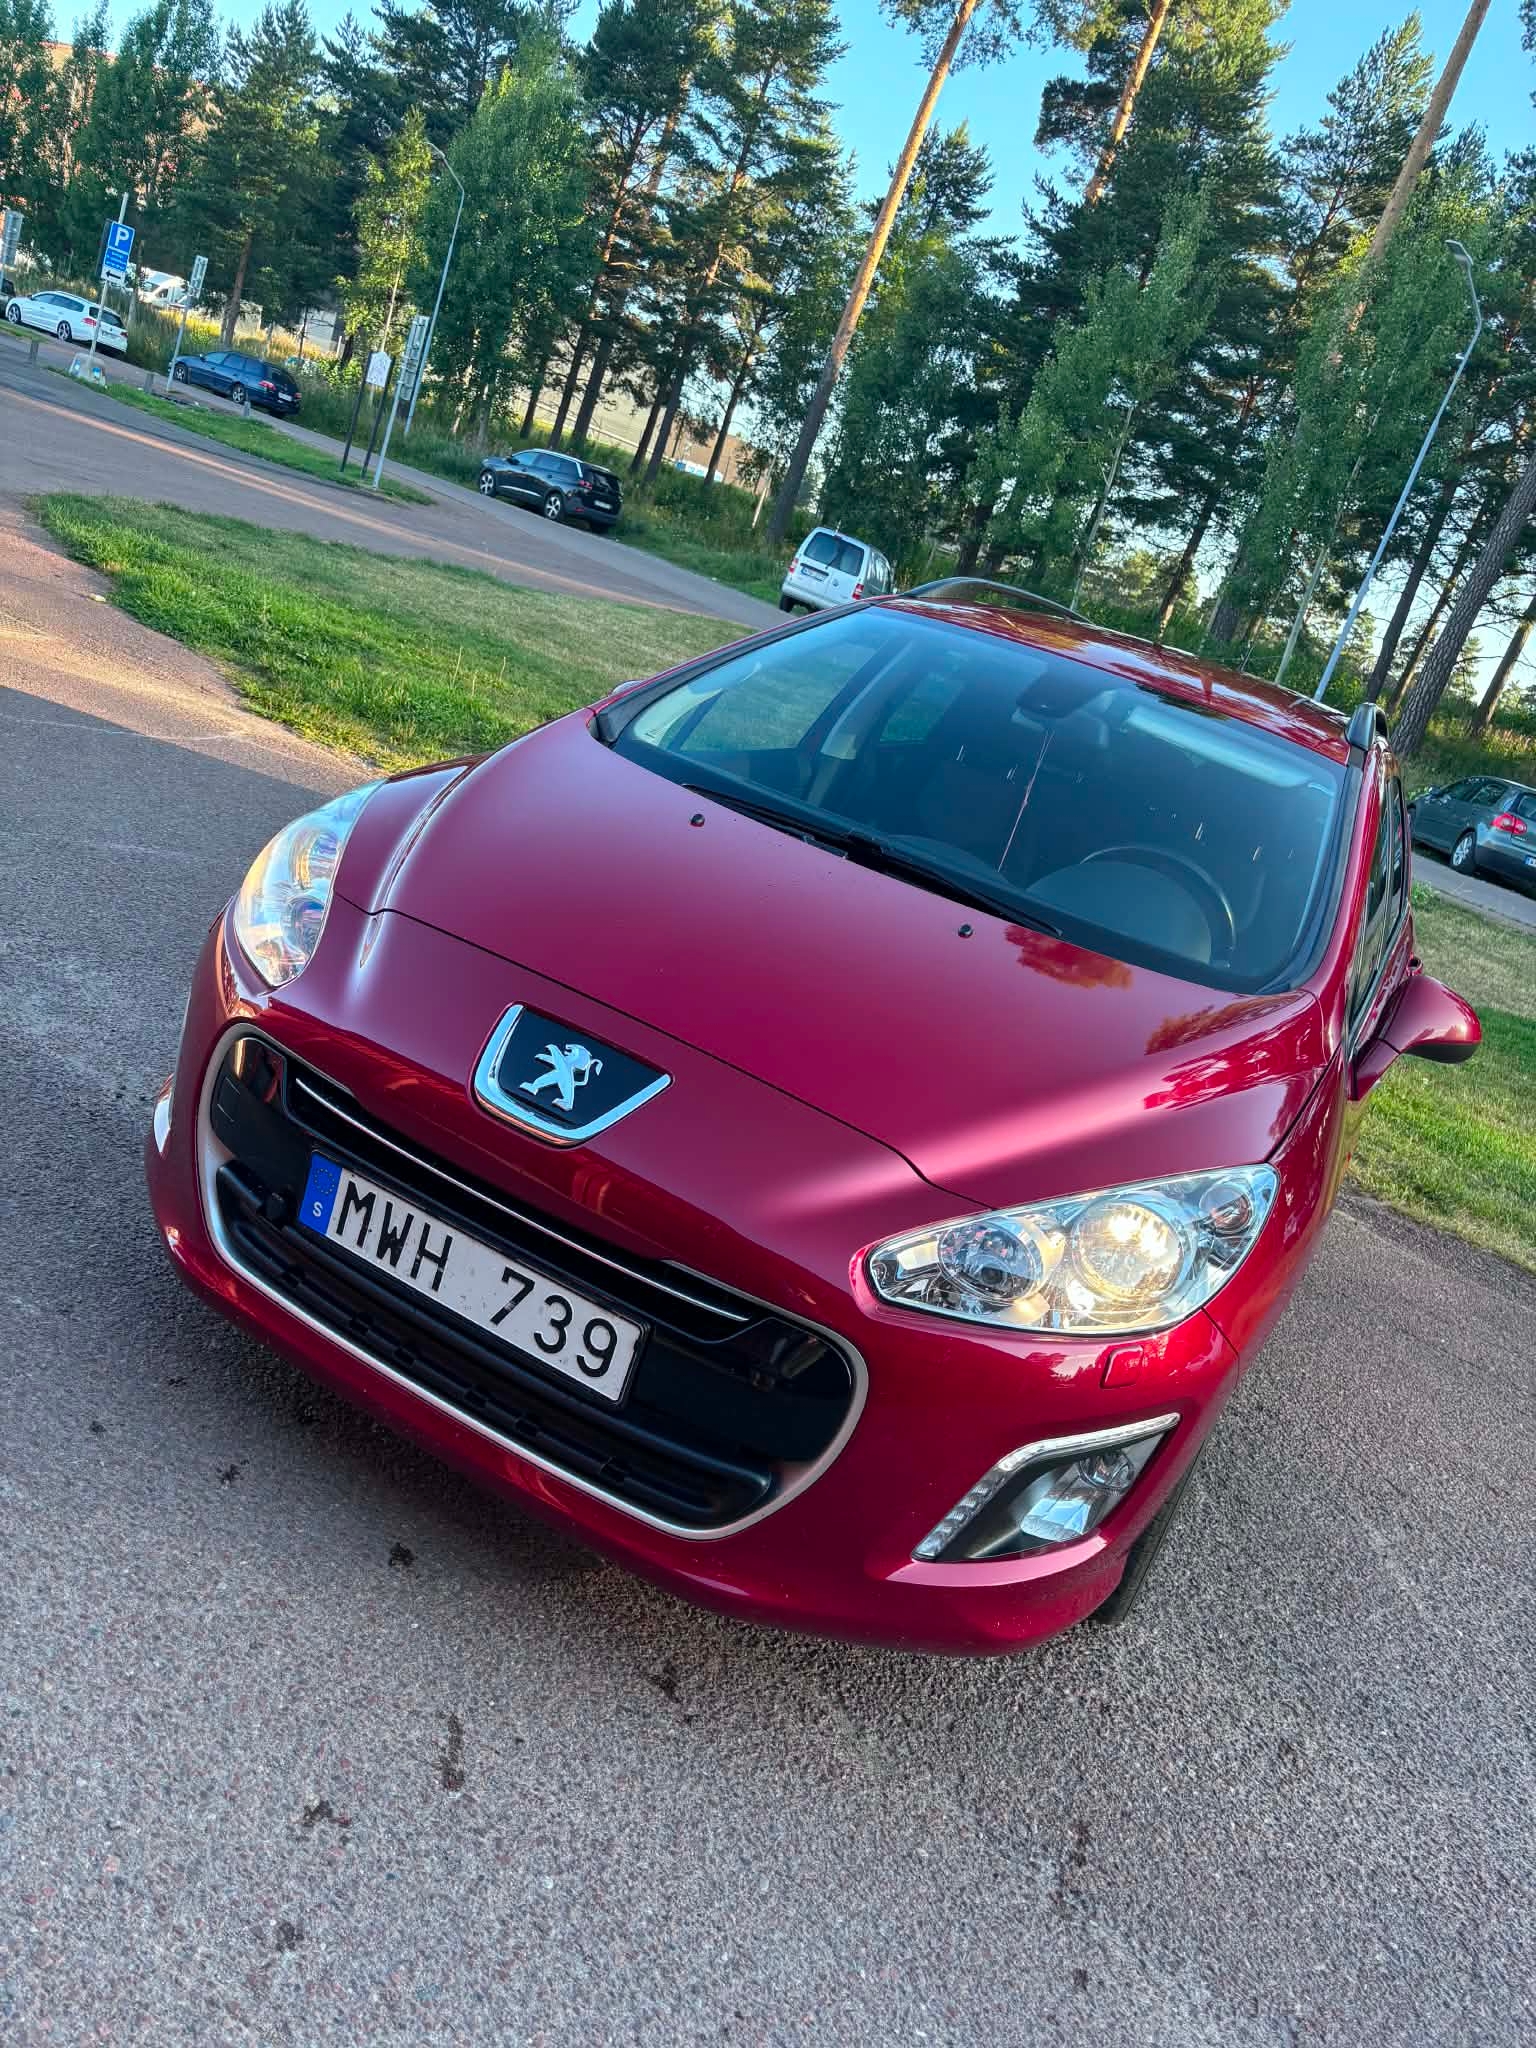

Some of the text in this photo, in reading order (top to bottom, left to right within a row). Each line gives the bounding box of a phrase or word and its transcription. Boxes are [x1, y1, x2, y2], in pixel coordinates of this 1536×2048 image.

[115, 227, 129, 246] P
[312, 1201, 324, 1217] S
[335, 1180, 618, 1378] MWH 739
